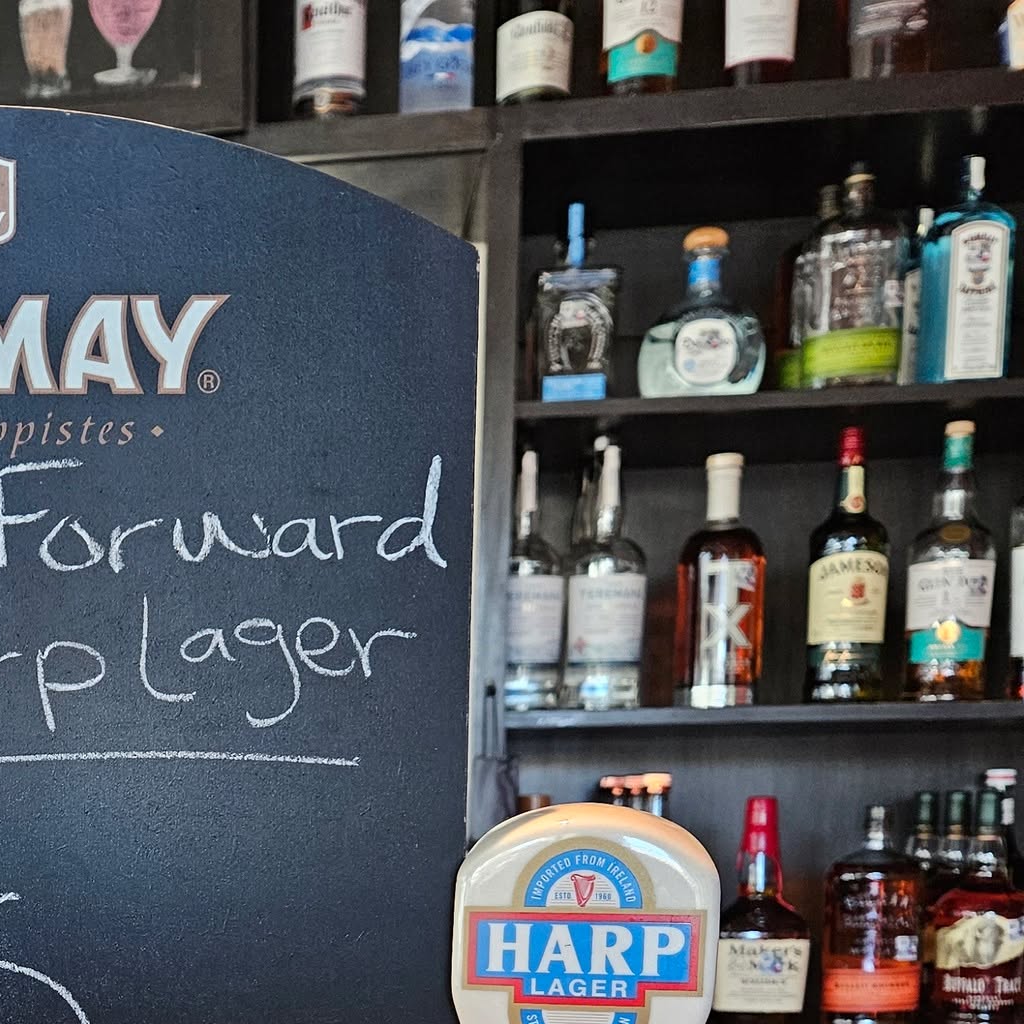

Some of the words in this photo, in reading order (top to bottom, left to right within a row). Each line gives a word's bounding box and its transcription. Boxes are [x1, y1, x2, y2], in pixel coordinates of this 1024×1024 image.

[141, 595, 417, 727] Lager
[531, 857, 572, 901] IMPORTED
[575, 854, 606, 867] FROM
[607, 862, 637, 903] IRELAND
[554, 891, 572, 900] ESTD
[485, 922, 686, 977] HARP
[530, 977, 628, 999] LAGER
